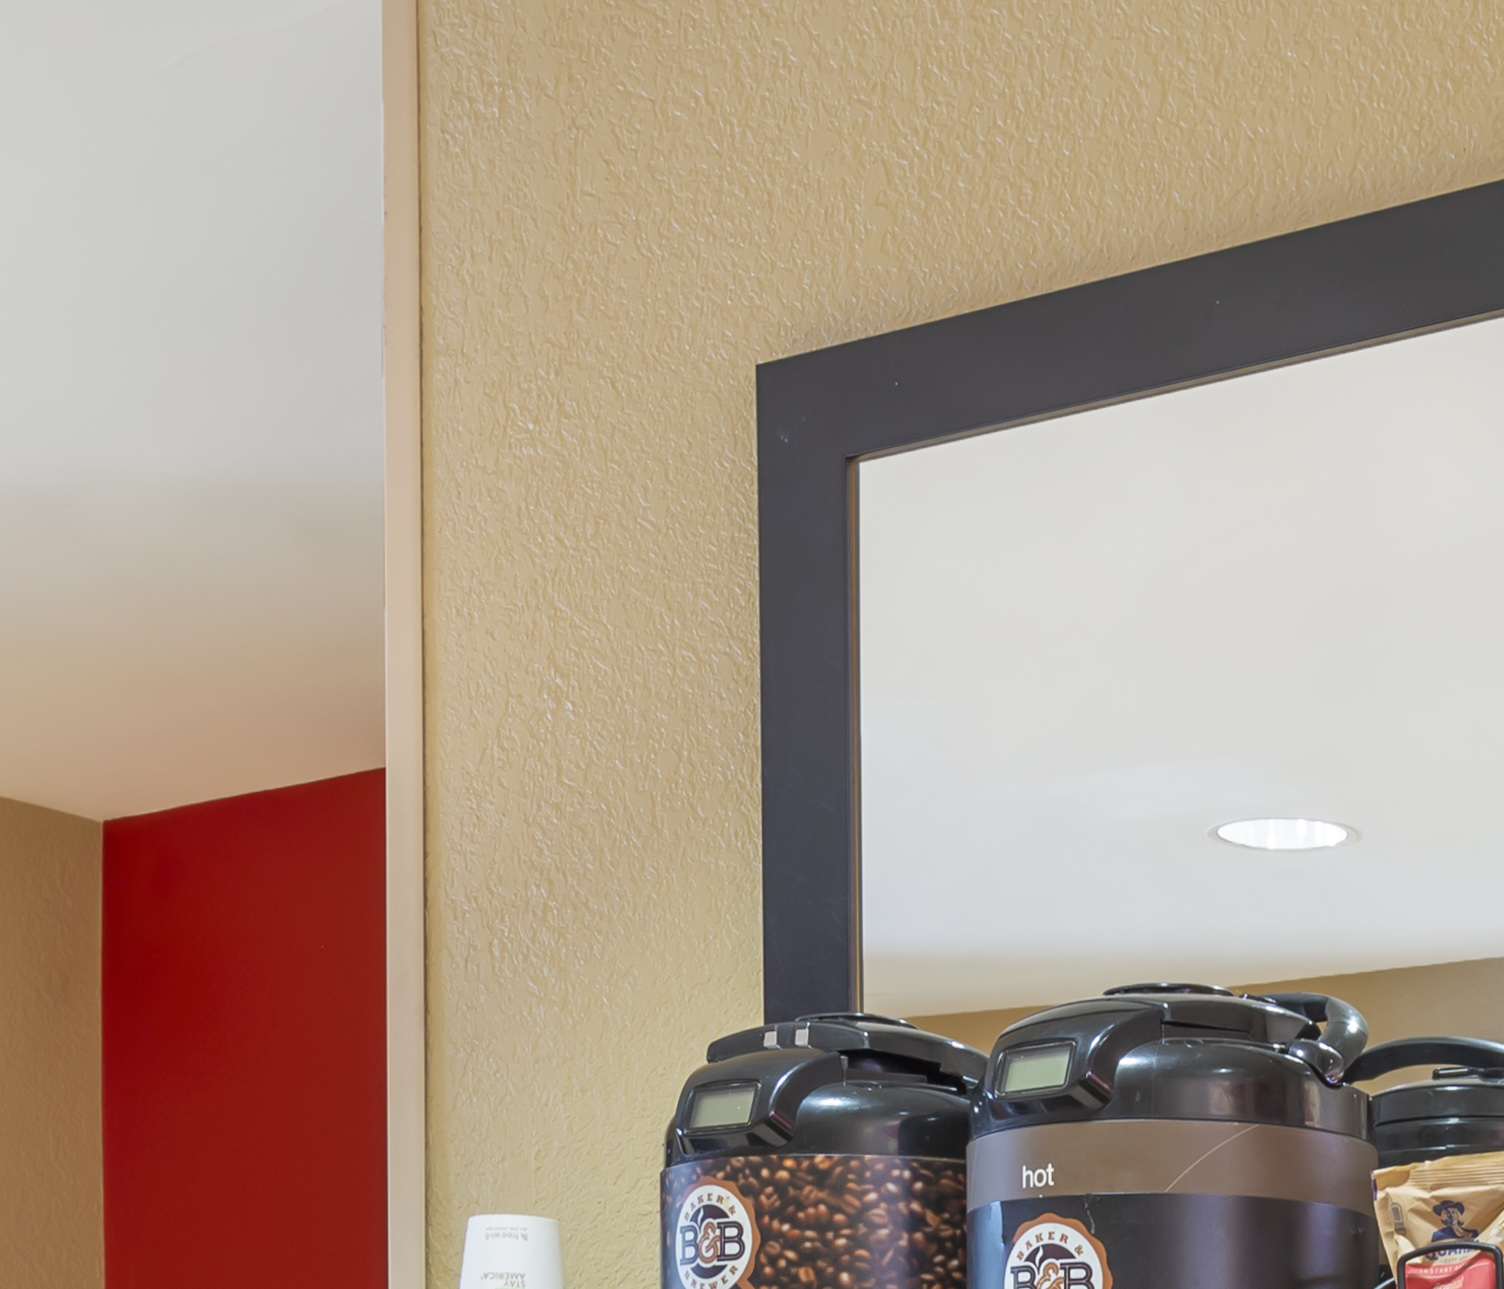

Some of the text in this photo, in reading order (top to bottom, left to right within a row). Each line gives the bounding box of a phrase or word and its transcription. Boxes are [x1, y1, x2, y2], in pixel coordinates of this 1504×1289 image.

[1022, 1163, 1055, 1188] hot
[680, 1220, 745, 1266] B&B
[1016, 1231, 1069, 1261] BAKER
